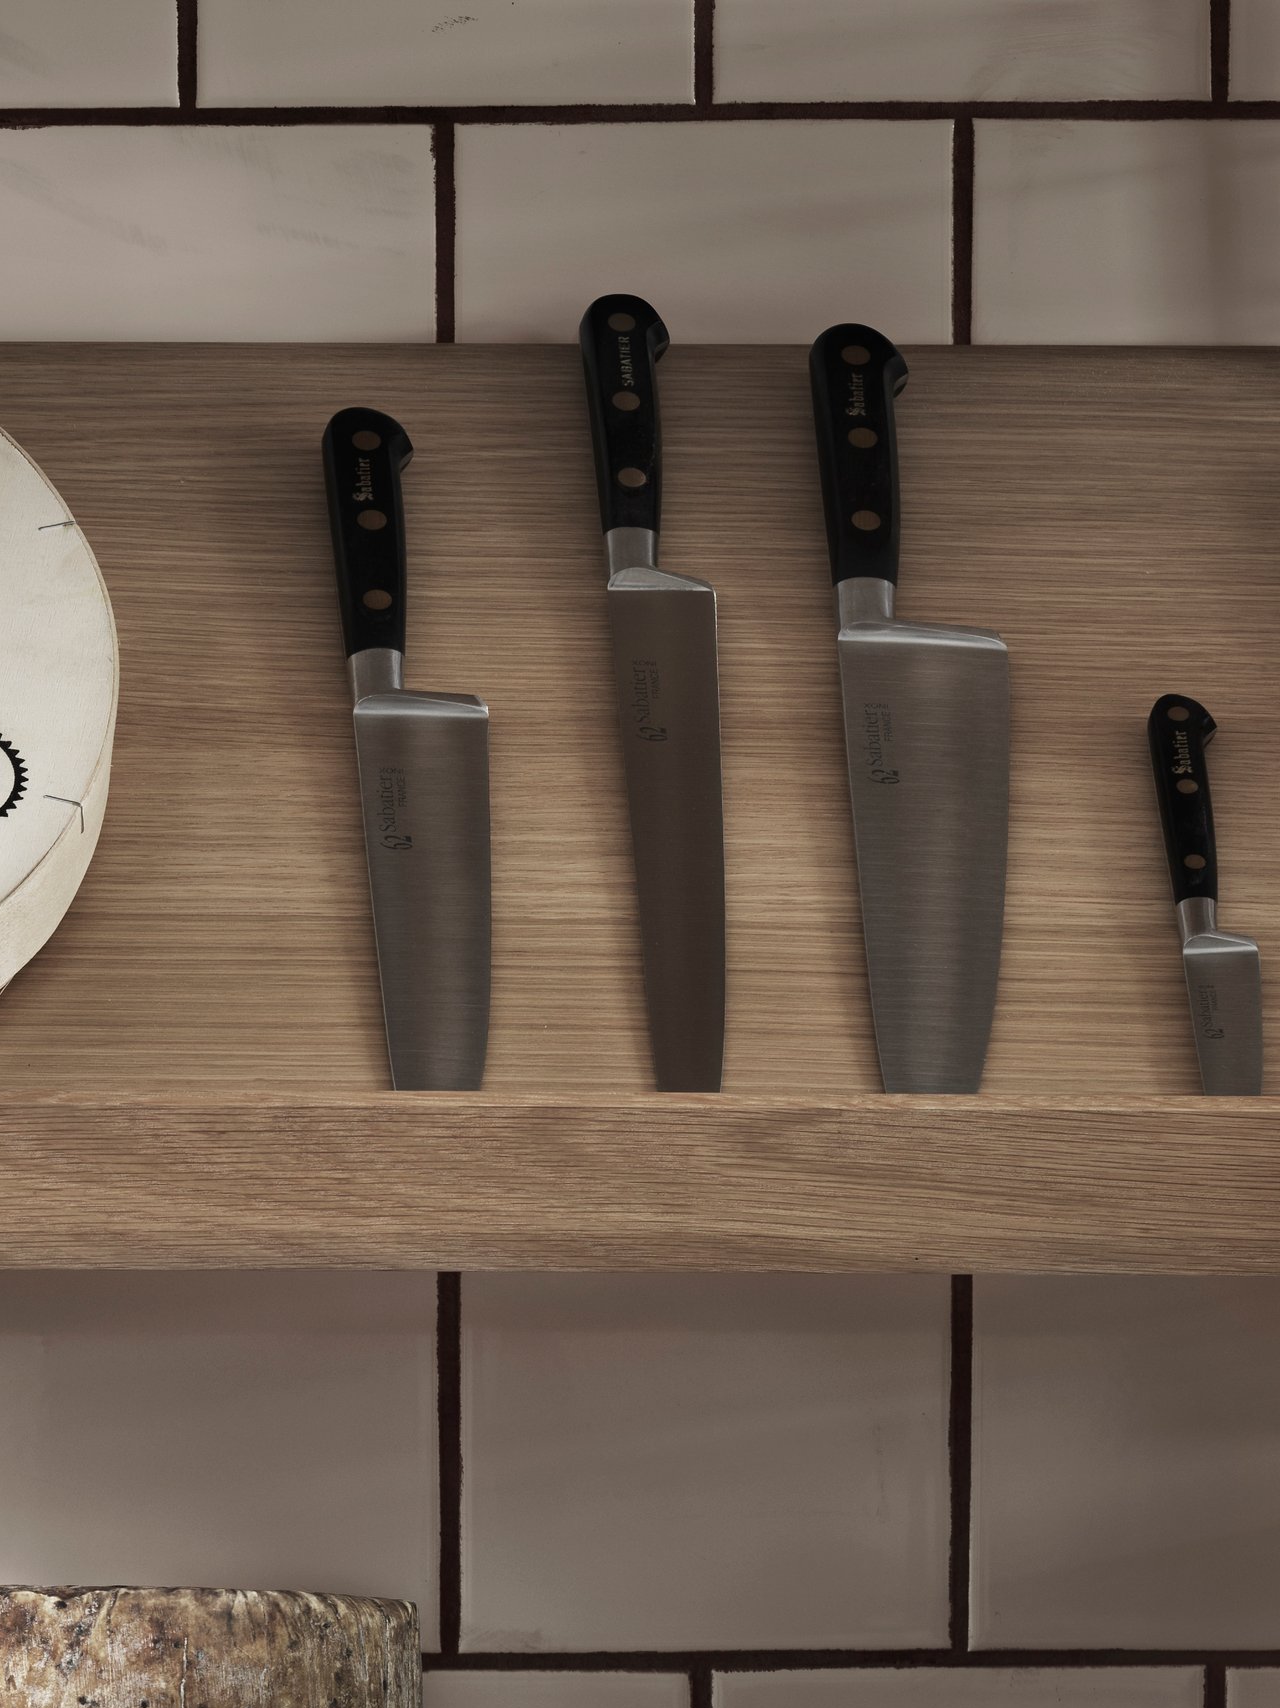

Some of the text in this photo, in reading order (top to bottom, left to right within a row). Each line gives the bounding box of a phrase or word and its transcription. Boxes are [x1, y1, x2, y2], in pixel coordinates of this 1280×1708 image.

[618, 336, 638, 386] SABATIER
[862, 710, 900, 784] 62 Sabatier
[1171, 729, 1193, 774] Sabatier
[377, 774, 413, 850] 62 Sabatier
